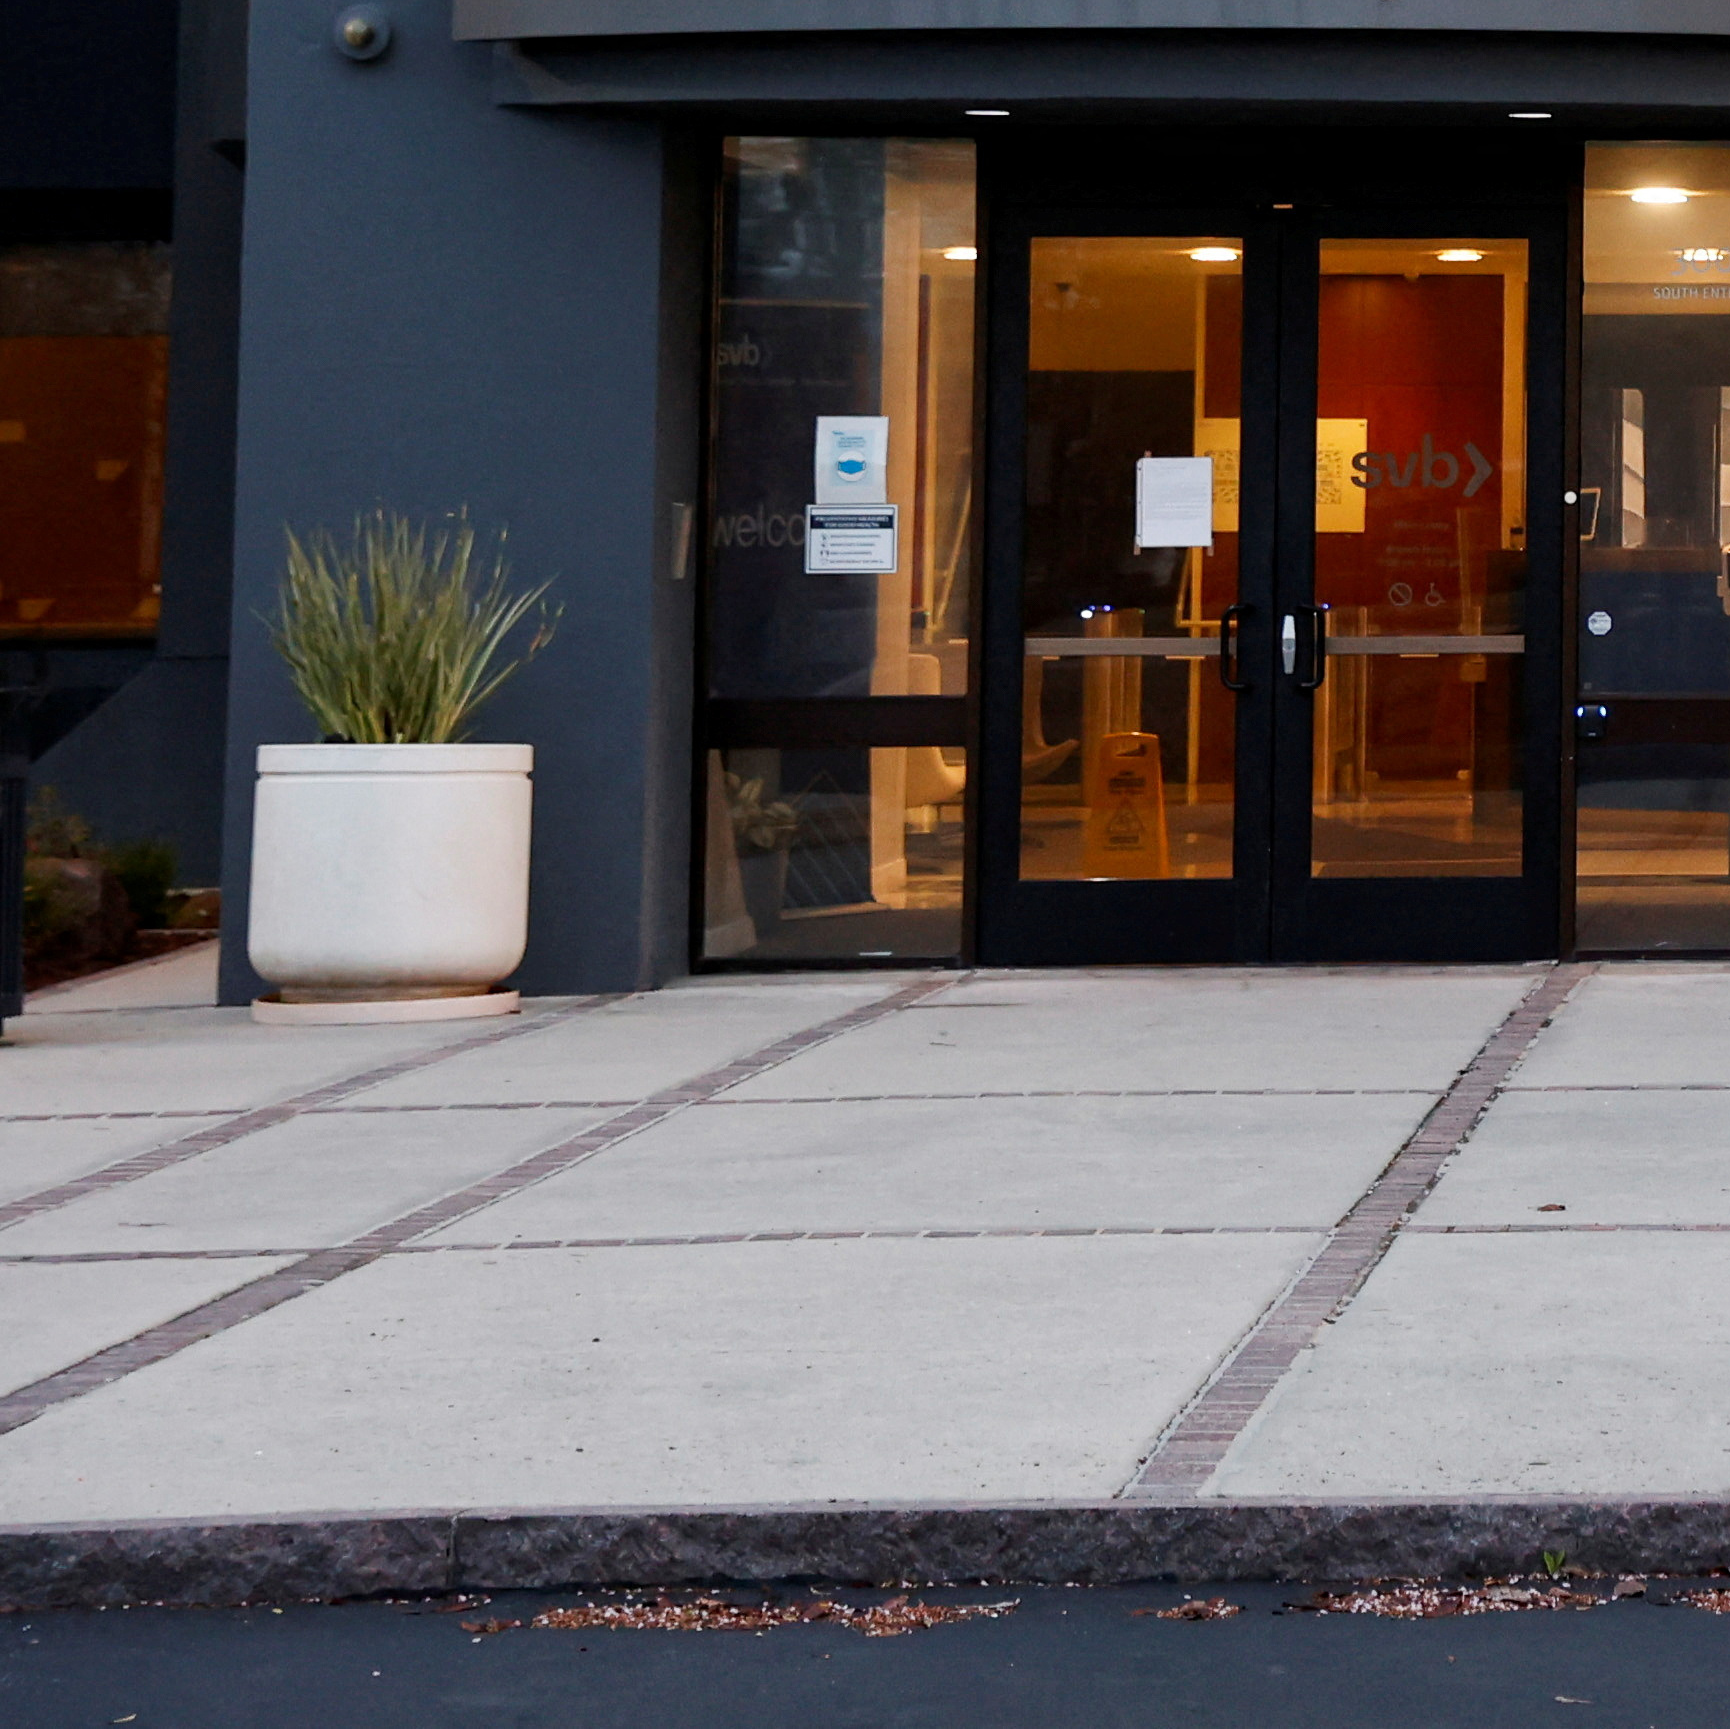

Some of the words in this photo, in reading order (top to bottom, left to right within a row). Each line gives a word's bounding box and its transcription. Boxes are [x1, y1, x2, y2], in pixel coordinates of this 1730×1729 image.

[1653, 286, 1699, 300] SOUTH
[1350, 432, 1460, 489] svb
[712, 503, 806, 548] welco
